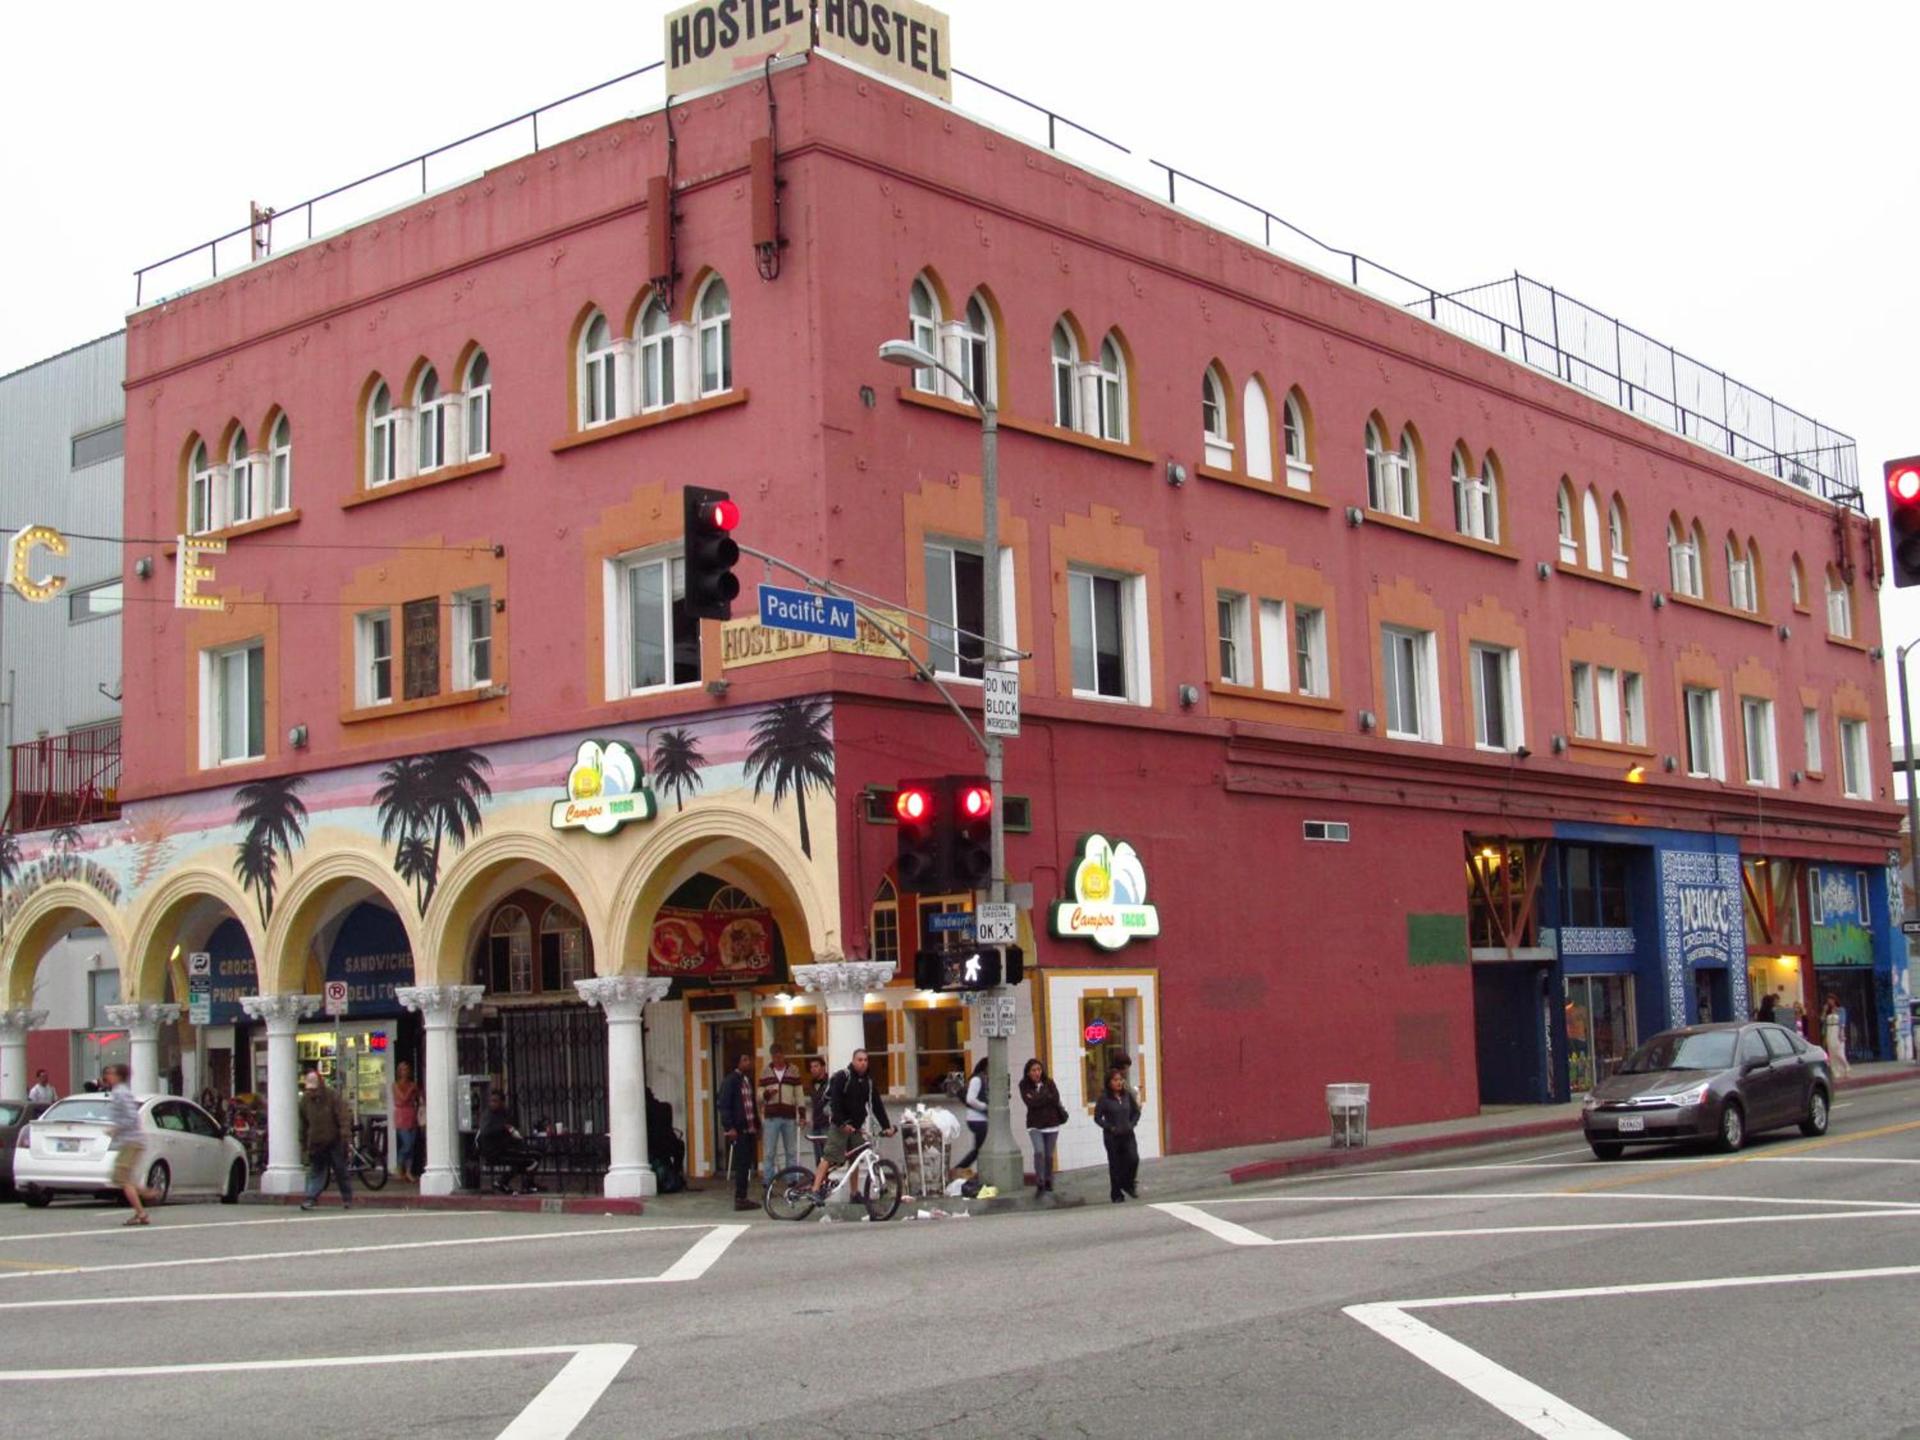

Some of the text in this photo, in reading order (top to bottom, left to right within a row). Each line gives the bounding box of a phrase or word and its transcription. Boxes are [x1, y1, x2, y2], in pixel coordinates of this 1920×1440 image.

[669, 0, 804, 69] HOSTEL
[824, 0, 948, 81] HOSTEL
[7, 524, 228, 611] C E
[767, 594, 850, 628] Pacific Av
[986, 677, 1017, 695] DO NOT
[986, 698, 1017, 716] BLOCK
[980, 923, 995, 939] OK
[1070, 906, 1147, 932] Campos TACOS
